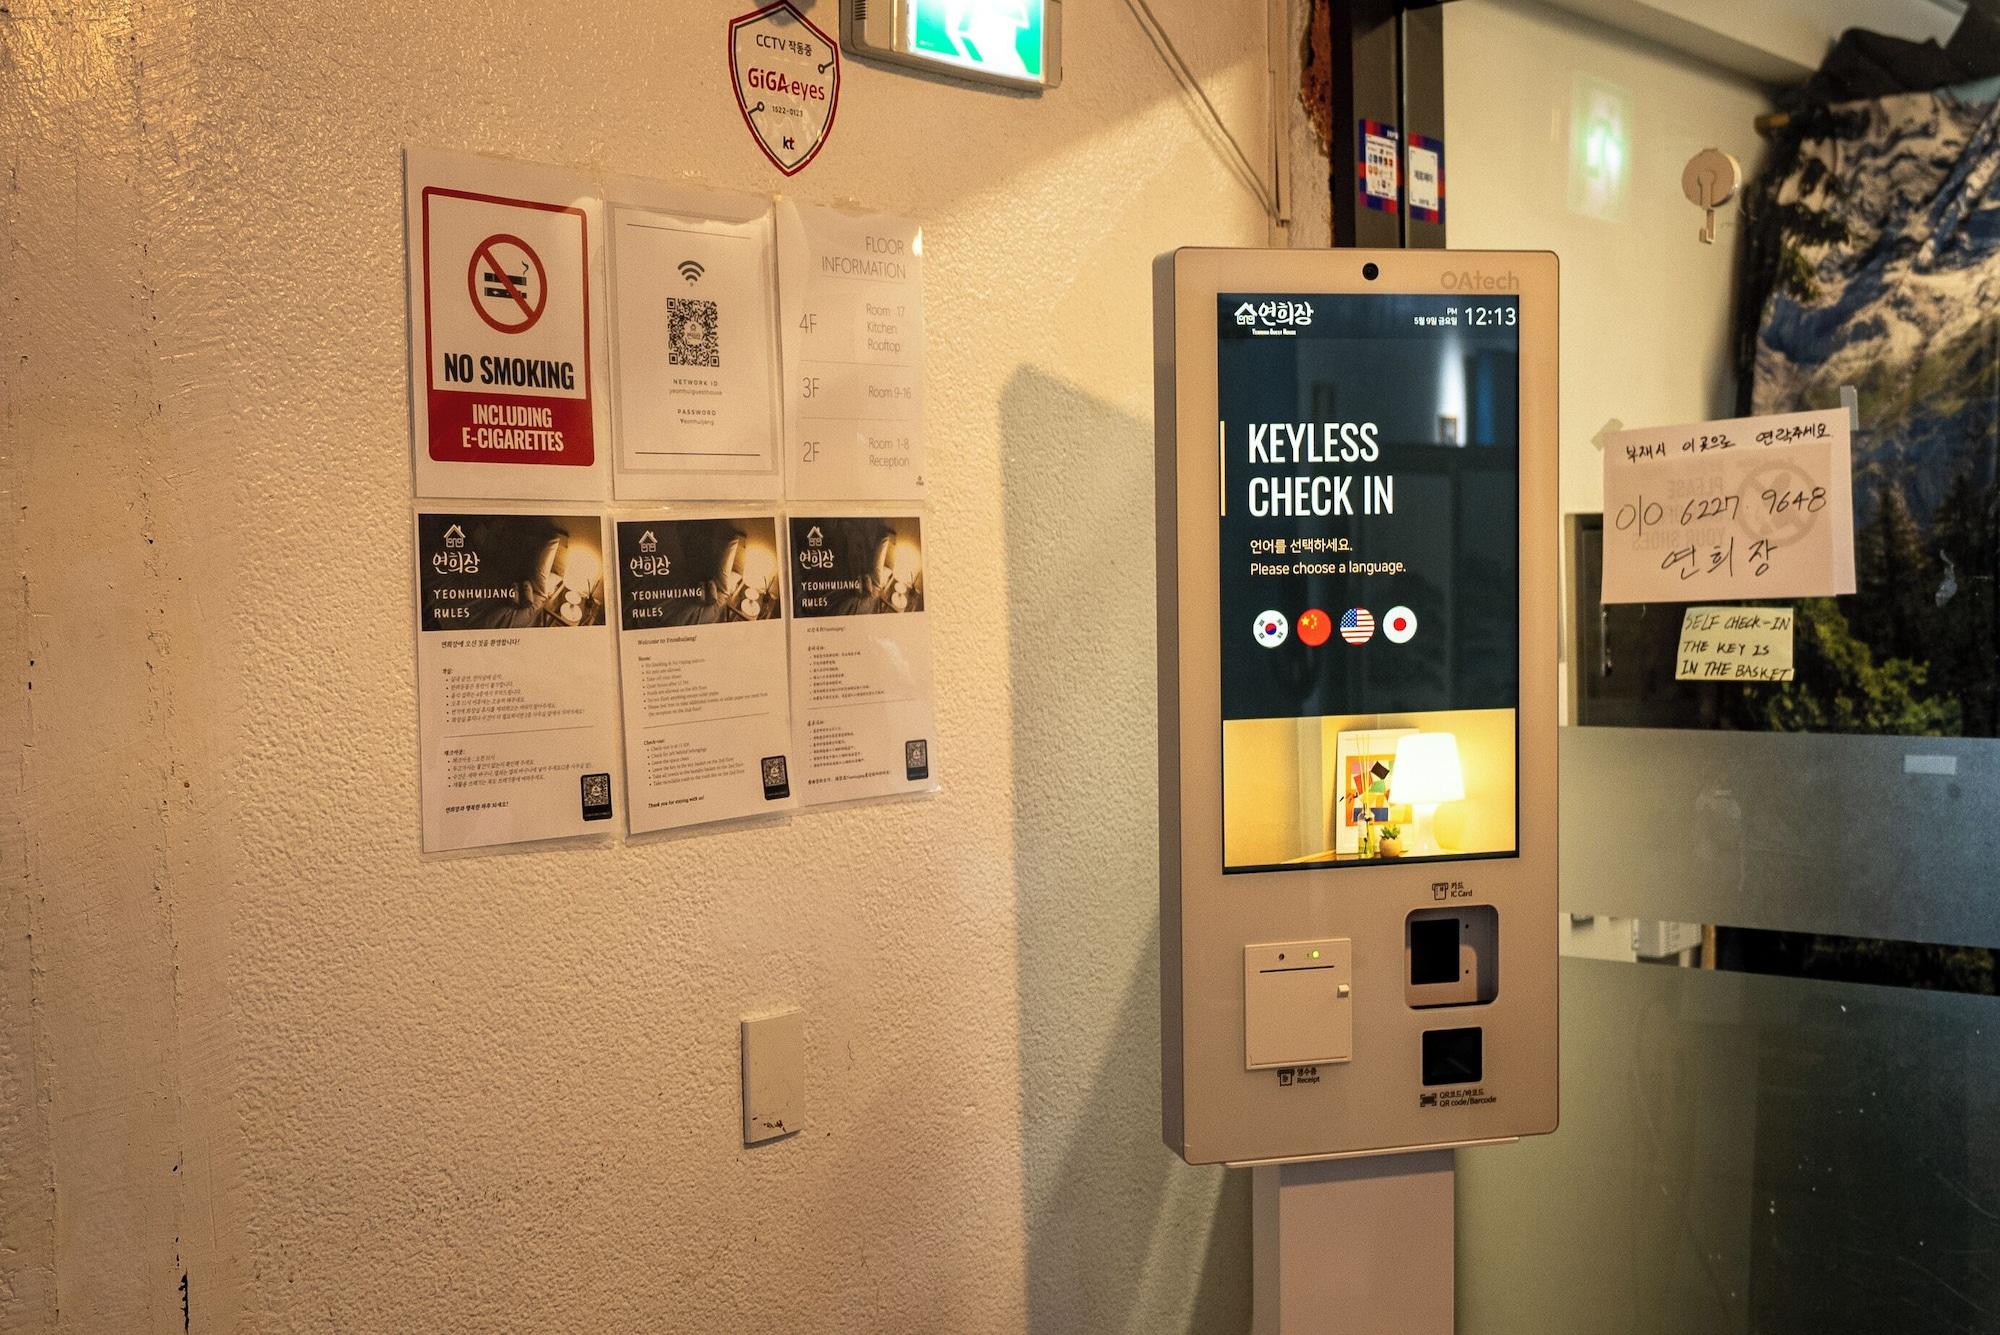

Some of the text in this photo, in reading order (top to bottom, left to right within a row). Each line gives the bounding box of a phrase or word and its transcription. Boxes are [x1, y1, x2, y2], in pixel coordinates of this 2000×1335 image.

[756, 34, 813, 57] CCTV 작동중
[771, 106, 804, 118] 1522-0123
[783, 136, 795, 151] kt
[865, 236, 904, 256] FLOOR
[821, 256, 906, 280] INFORMATION
[1440, 269, 1519, 291] OAtech
[866, 303, 891, 317] Room
[1258, 300, 1314, 327] 연희장
[1446, 307, 1458, 315] PM
[1464, 307, 1516, 326] 12:13
[799, 313, 817, 335] 4F
[867, 321, 898, 335] Kitchen
[867, 339, 901, 353] Rooftop
[444, 352, 575, 390] NO SMOKING
[802, 377, 820, 399] 3F
[868, 386, 912, 399] Room 9-16
[472, 403, 553, 428] INCLUDING
[462, 427, 564, 452] E-CIGARETTES
[868, 437, 910, 450] Room 1-8
[1248, 422, 1379, 464] KEYLESS
[803, 441, 820, 463] 2F
[869, 455, 910, 468] Reception
[1248, 475, 1394, 517] CHECK IN
[1615, 494, 1663, 537] 010
[1680, 496, 1740, 526] 6227
[1761, 487, 1826, 515] 9648
[1250, 537, 1353, 554] 언어를 선택하세요.
[432, 551, 481, 575] 연희장
[630, 554, 671, 578] 연희장
[799, 548, 834, 570] 연희장
[1250, 560, 1407, 576] Please choose a language.
[433, 588, 516, 600] YEONHUIJANG
[631, 587, 703, 601] YEONHUIJANG
[801, 580, 860, 591] YEONHUIJANG
[802, 597, 828, 608] RULES
[434, 607, 470, 619] RULES
[632, 606, 664, 619] RULES
[1684, 614, 1791, 631] SELF CHECK-IN
[1682, 640, 1769, 656] THE KEY IS
[1680, 660, 1791, 680] IN THE BASKET
[1458, 890, 1473, 898] Card
